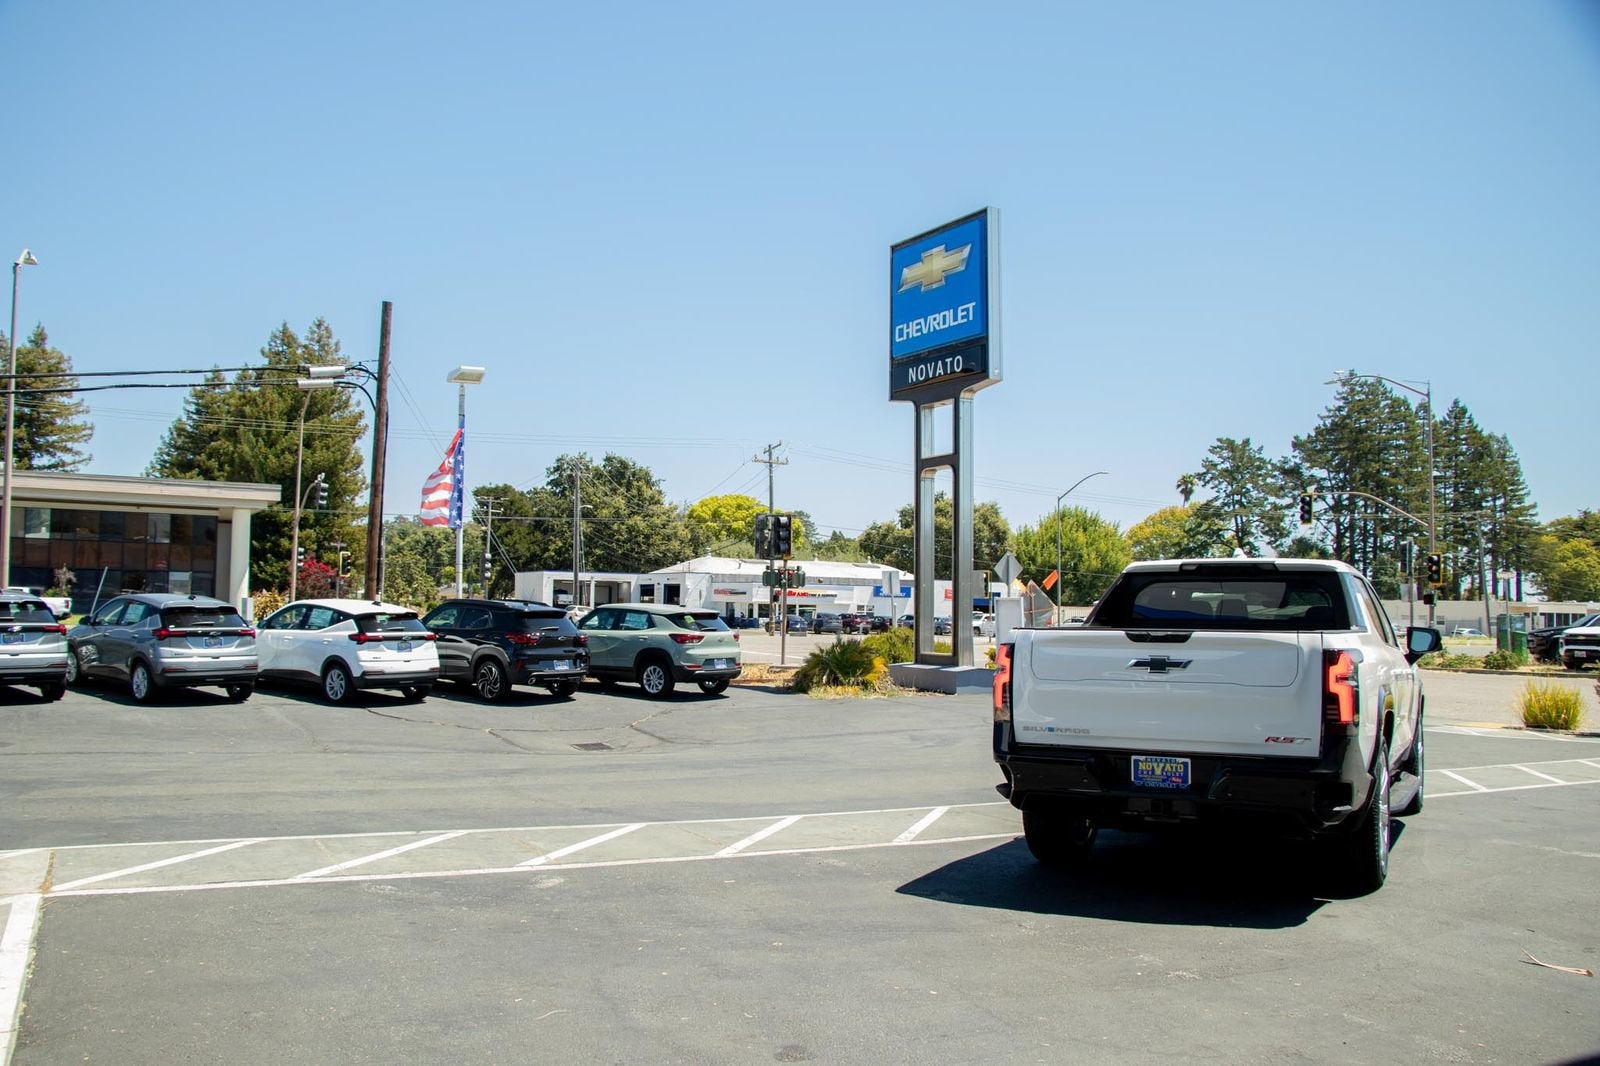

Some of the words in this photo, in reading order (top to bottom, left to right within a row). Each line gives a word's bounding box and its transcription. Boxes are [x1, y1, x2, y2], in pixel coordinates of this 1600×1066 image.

[895, 302, 976, 342] CHEVROLET
[908, 355, 963, 384] NOVATO
[1138, 761, 1184, 776] NOVATO
